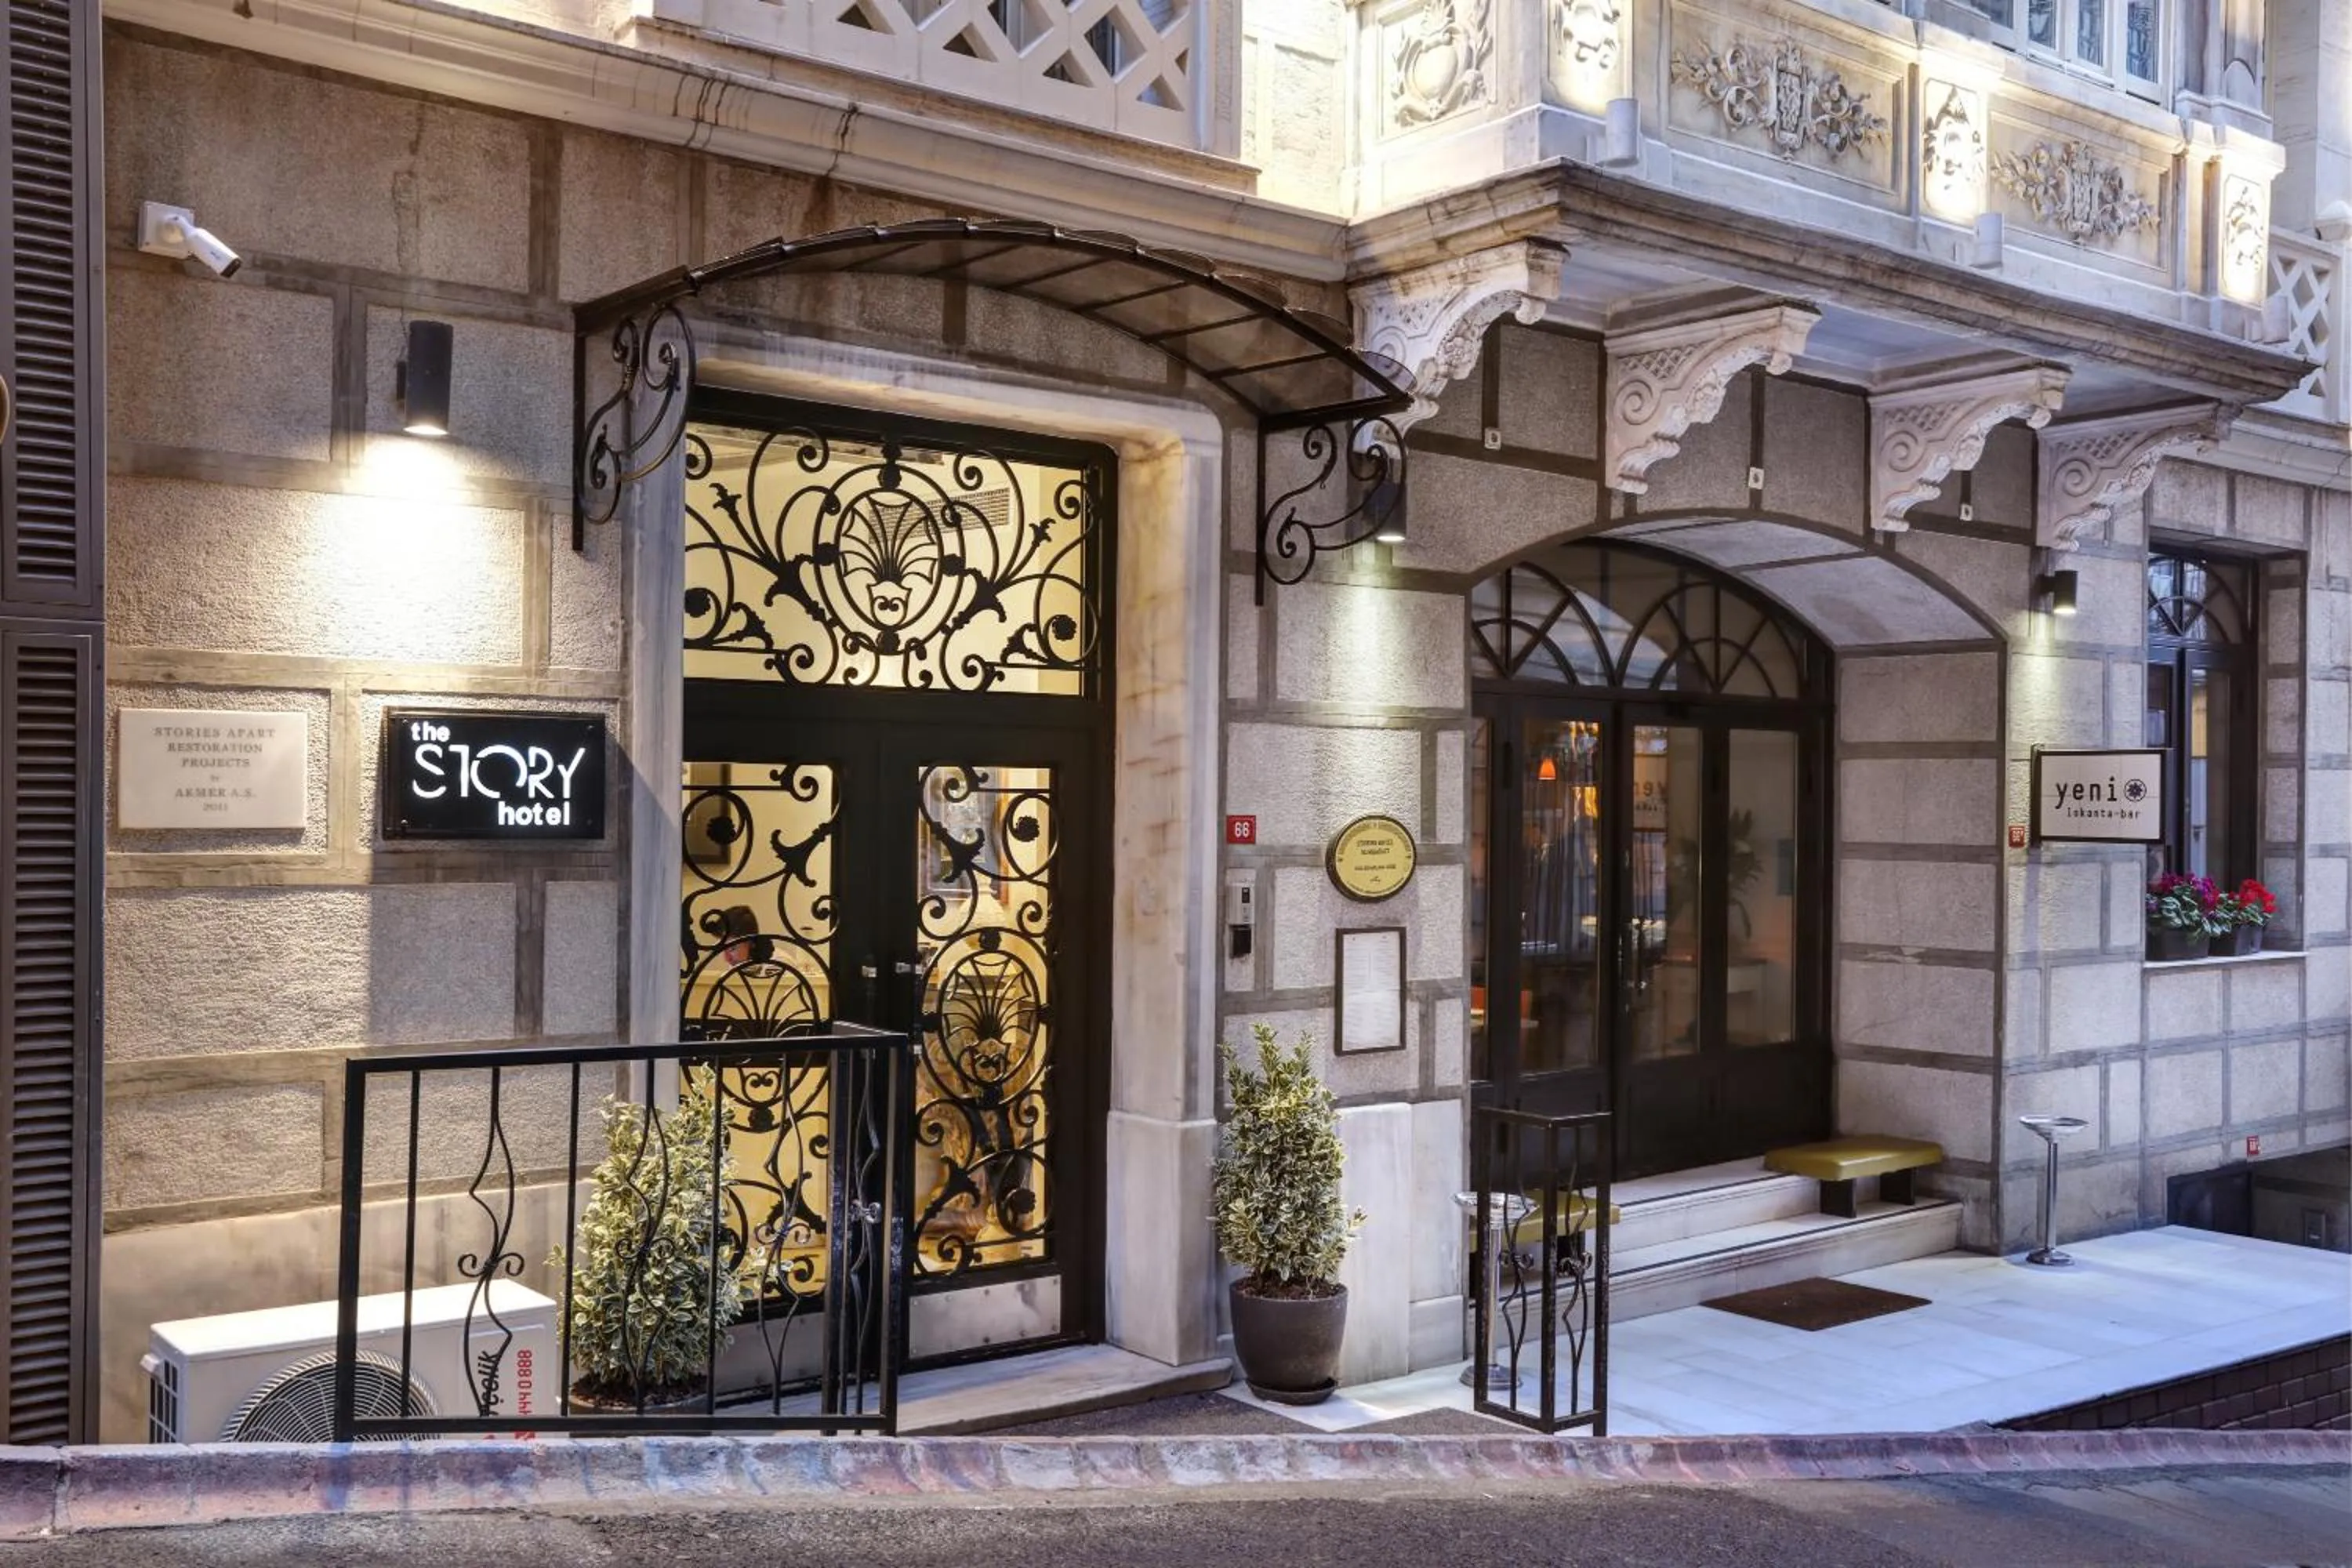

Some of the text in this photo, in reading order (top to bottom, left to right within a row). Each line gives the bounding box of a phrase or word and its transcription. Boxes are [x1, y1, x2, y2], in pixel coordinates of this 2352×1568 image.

[153, 726, 277, 739] STORIES APART
[411, 721, 451, 742] the
[167, 742, 263, 753] RESTORATION
[181, 757, 251, 768] PROJECTS
[412, 743, 586, 799] STORY
[2054, 775, 2118, 810] yeni
[498, 800, 571, 826] hotel
